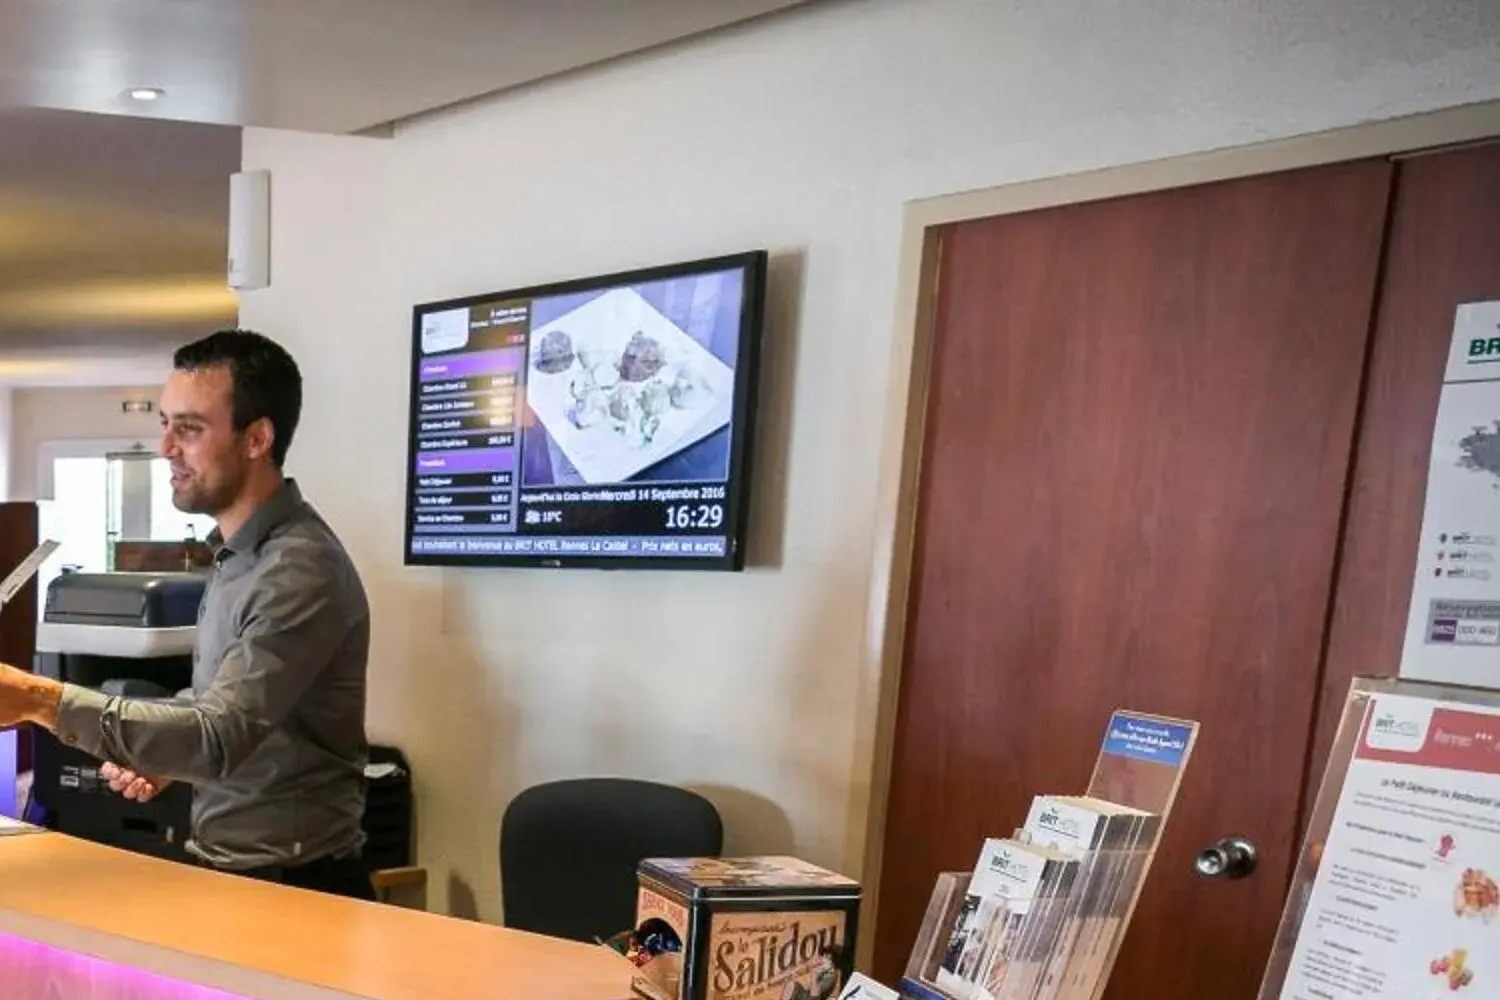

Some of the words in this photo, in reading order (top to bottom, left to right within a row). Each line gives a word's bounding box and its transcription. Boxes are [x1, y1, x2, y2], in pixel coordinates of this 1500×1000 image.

[638, 488, 649, 500] 14
[651, 486, 699, 502] Septembre
[701, 484, 725, 499] 2016
[665, 503, 723, 528] 16:29
[713, 921, 837, 993] Salidou
